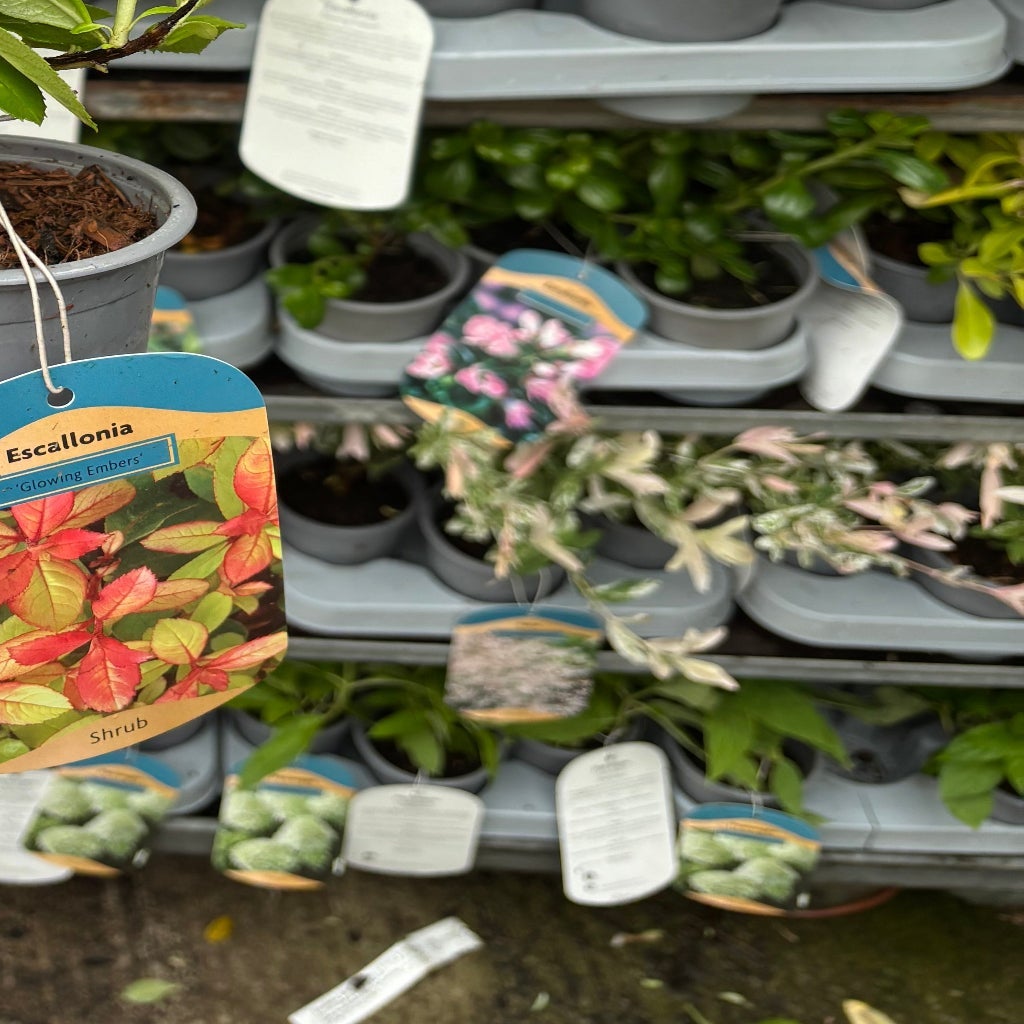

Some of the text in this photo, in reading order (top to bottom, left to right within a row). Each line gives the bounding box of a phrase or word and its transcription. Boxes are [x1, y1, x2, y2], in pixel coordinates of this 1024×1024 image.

[6, 422, 134, 464] Escallonia
[15, 452, 144, 493] 'Glowing Embers'
[89, 716, 148, 745] Shrub
